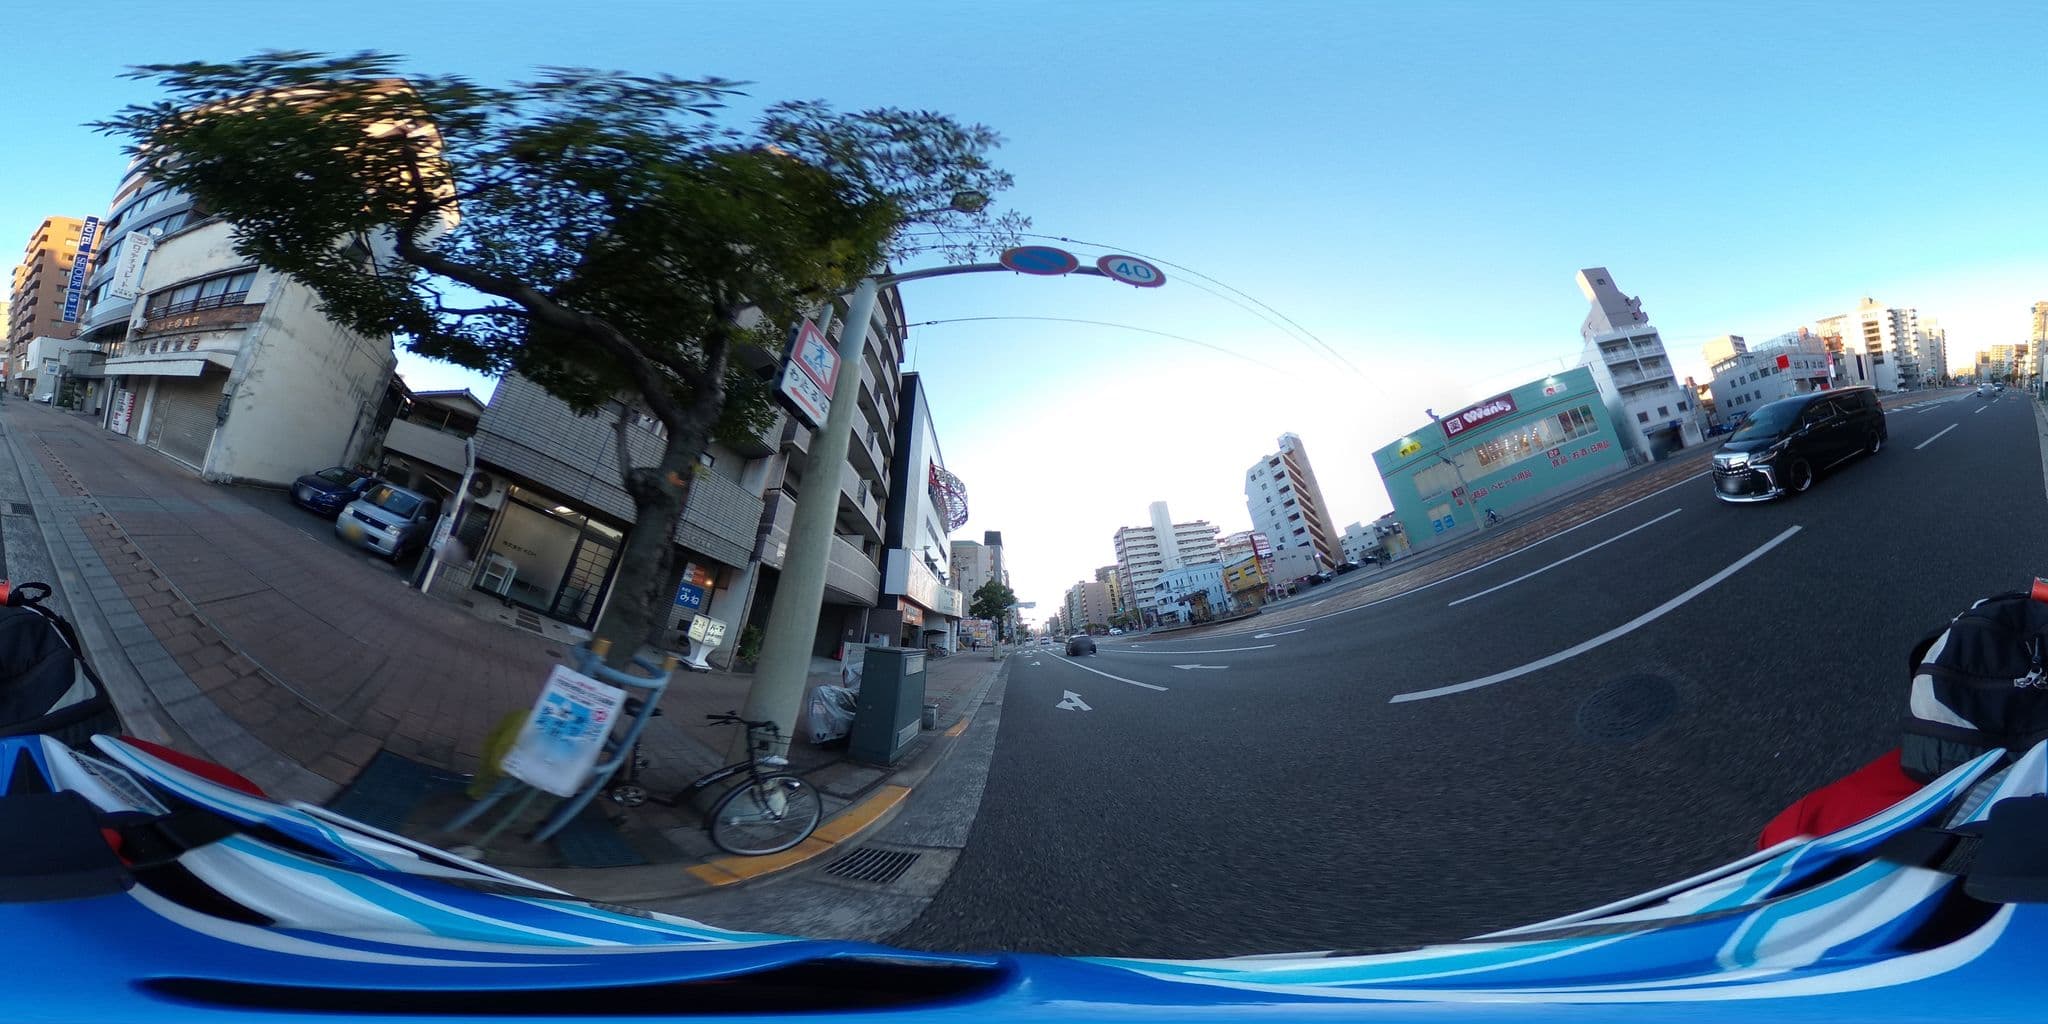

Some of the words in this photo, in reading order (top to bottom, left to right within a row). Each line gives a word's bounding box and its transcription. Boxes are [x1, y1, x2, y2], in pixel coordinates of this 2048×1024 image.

[81, 221, 97, 247] HOTEL
[72, 257, 86, 287] SEJOUR
[1116, 262, 1151, 279] 40
[789, 367, 828, 413] わたるな
[680, 592, 700, 606] みね
